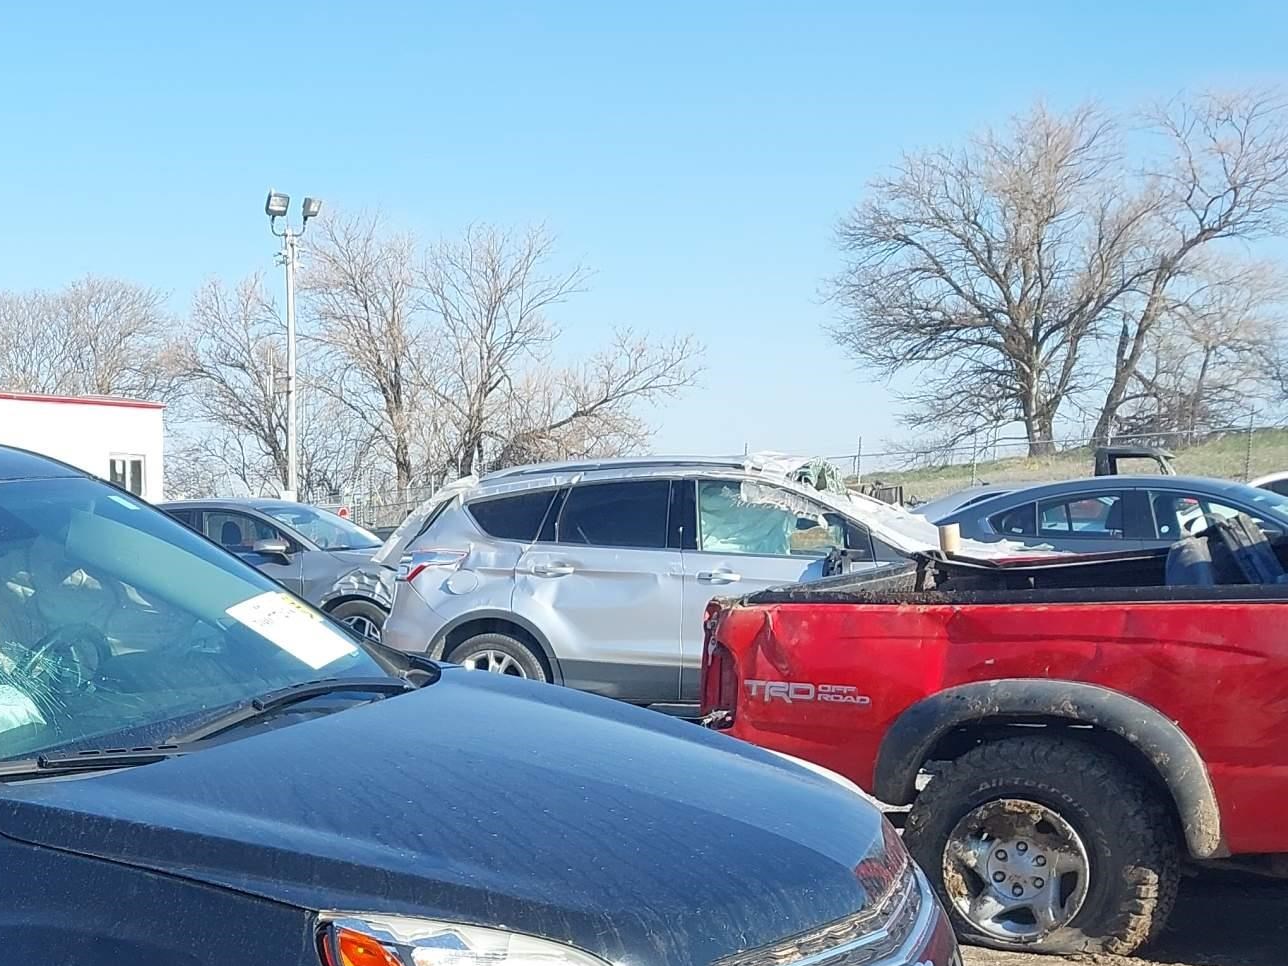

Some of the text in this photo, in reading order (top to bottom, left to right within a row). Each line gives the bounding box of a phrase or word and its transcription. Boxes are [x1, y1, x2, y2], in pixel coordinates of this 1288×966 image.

[743, 679, 815, 704] TRD
[818, 683, 857, 694] OFF
[817, 693, 871, 705] ROAD
